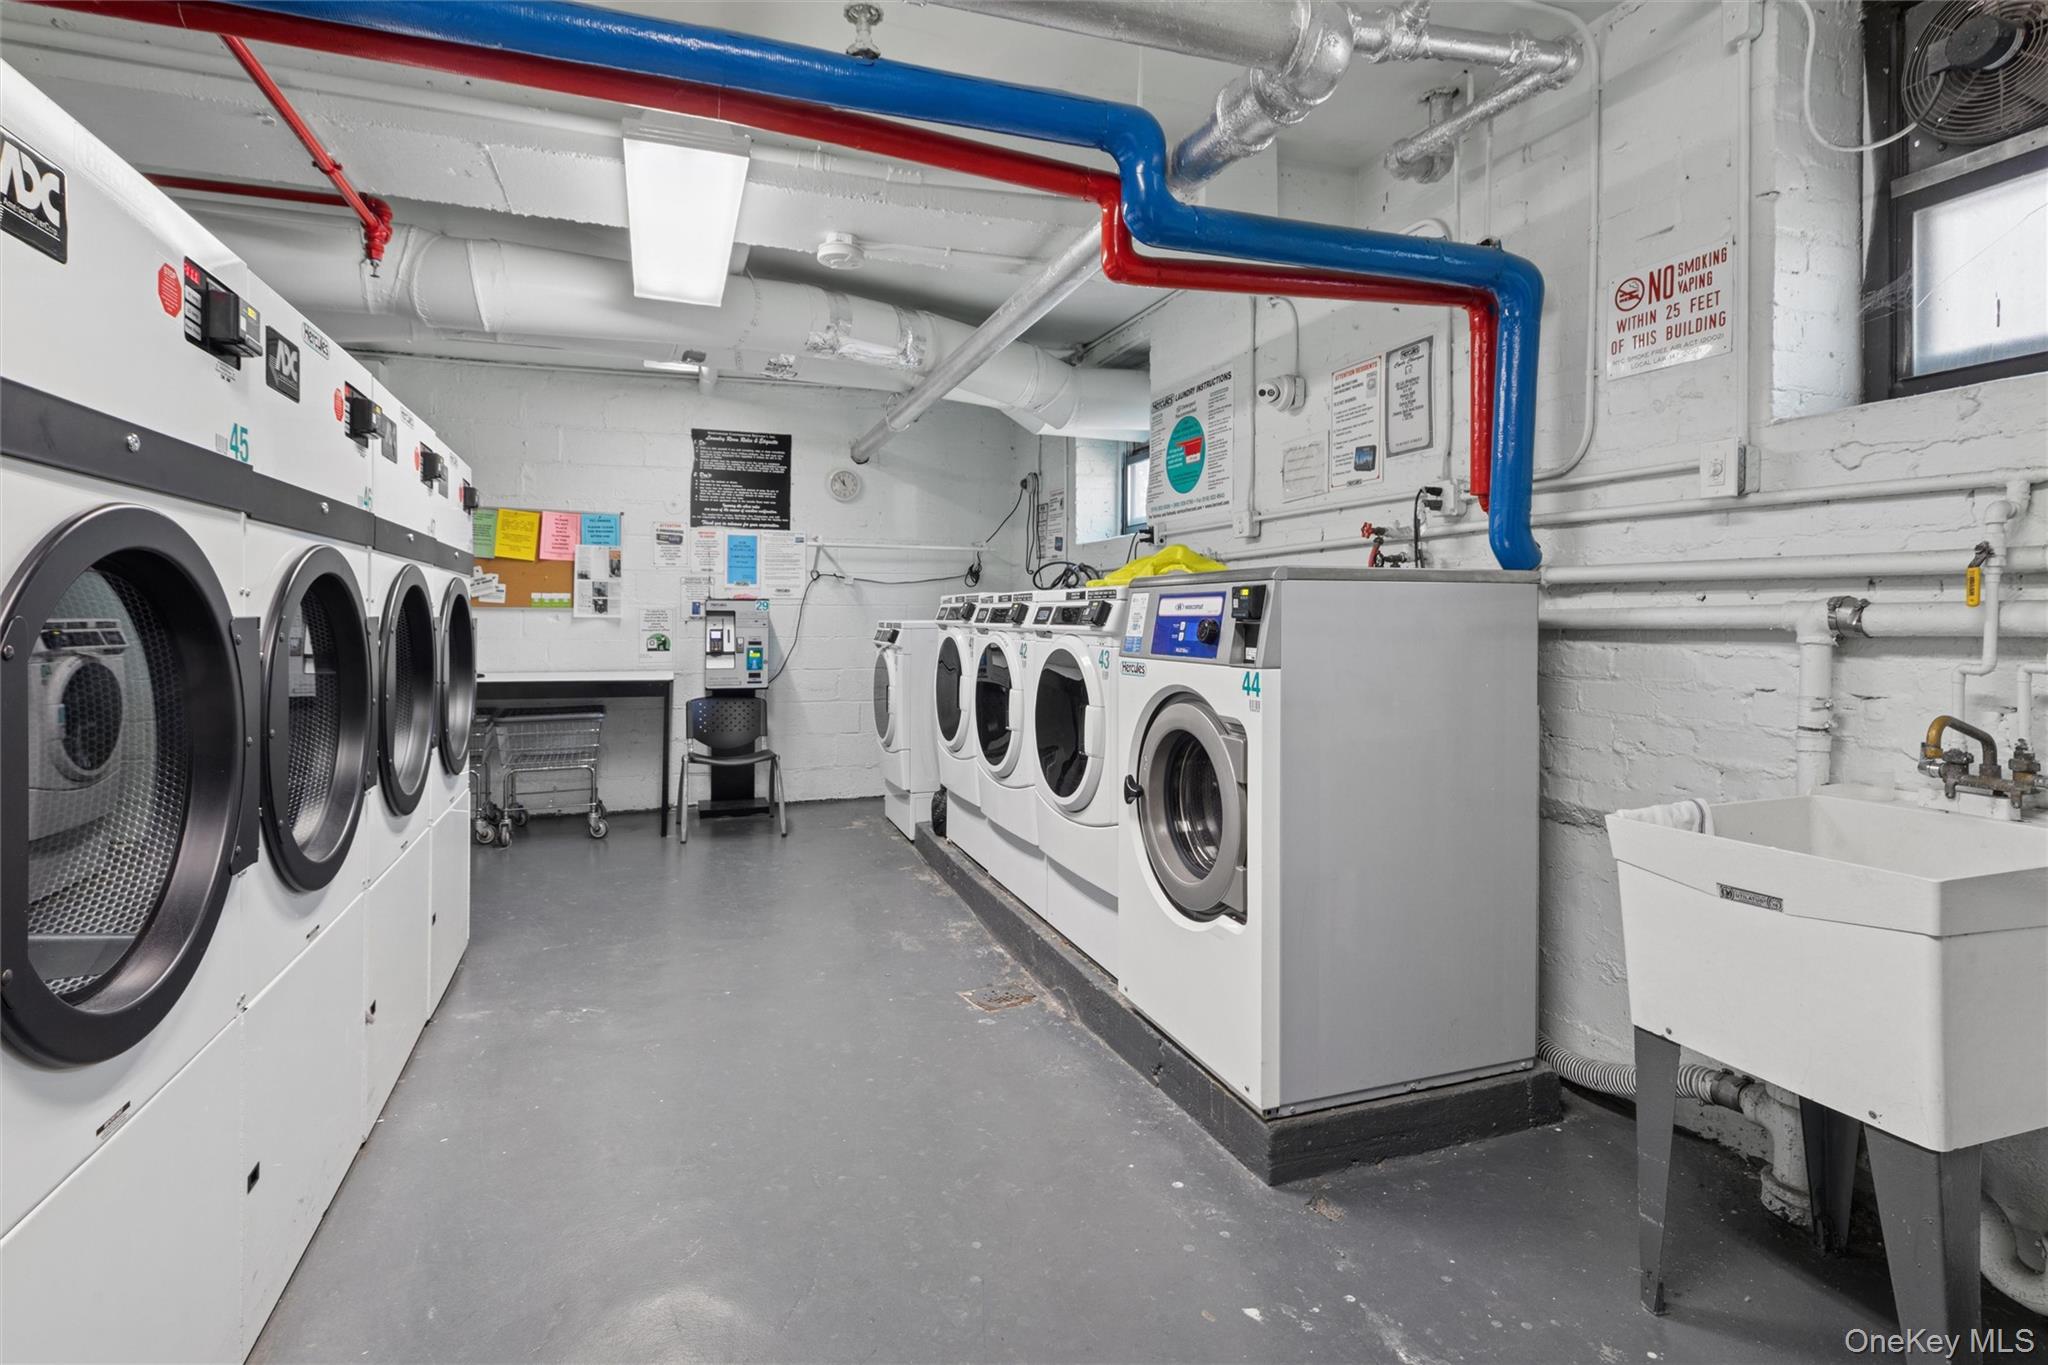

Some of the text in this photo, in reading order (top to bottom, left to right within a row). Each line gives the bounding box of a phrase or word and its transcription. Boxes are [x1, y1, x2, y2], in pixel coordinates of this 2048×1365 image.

[0, 141, 60, 227] ADC
[1678, 247, 1727, 277] SMOKING
[1648, 265, 1674, 304] NO
[1678, 271, 1712, 294] VAPING
[1617, 290, 1720, 334] WITHIN 25 FEET
[1611, 311, 1726, 355] OF THIS BUILDING
[1627, 352, 1649, 362] SMOKE
[1651, 348, 1667, 356] FREE
[1684, 340, 1698, 349] ACT
[1631, 359, 1651, 370] LOCAL
[1175, 387, 1195, 401] LAUNDRY
[1196, 371, 1232, 392] INSTRUCTIONS
[230, 423, 249, 463] 45
[756, 601, 768, 611] 29
[1098, 649, 1110, 670] 43
[1122, 661, 1146, 675] Hercules
[1242, 670, 1261, 697] 44
